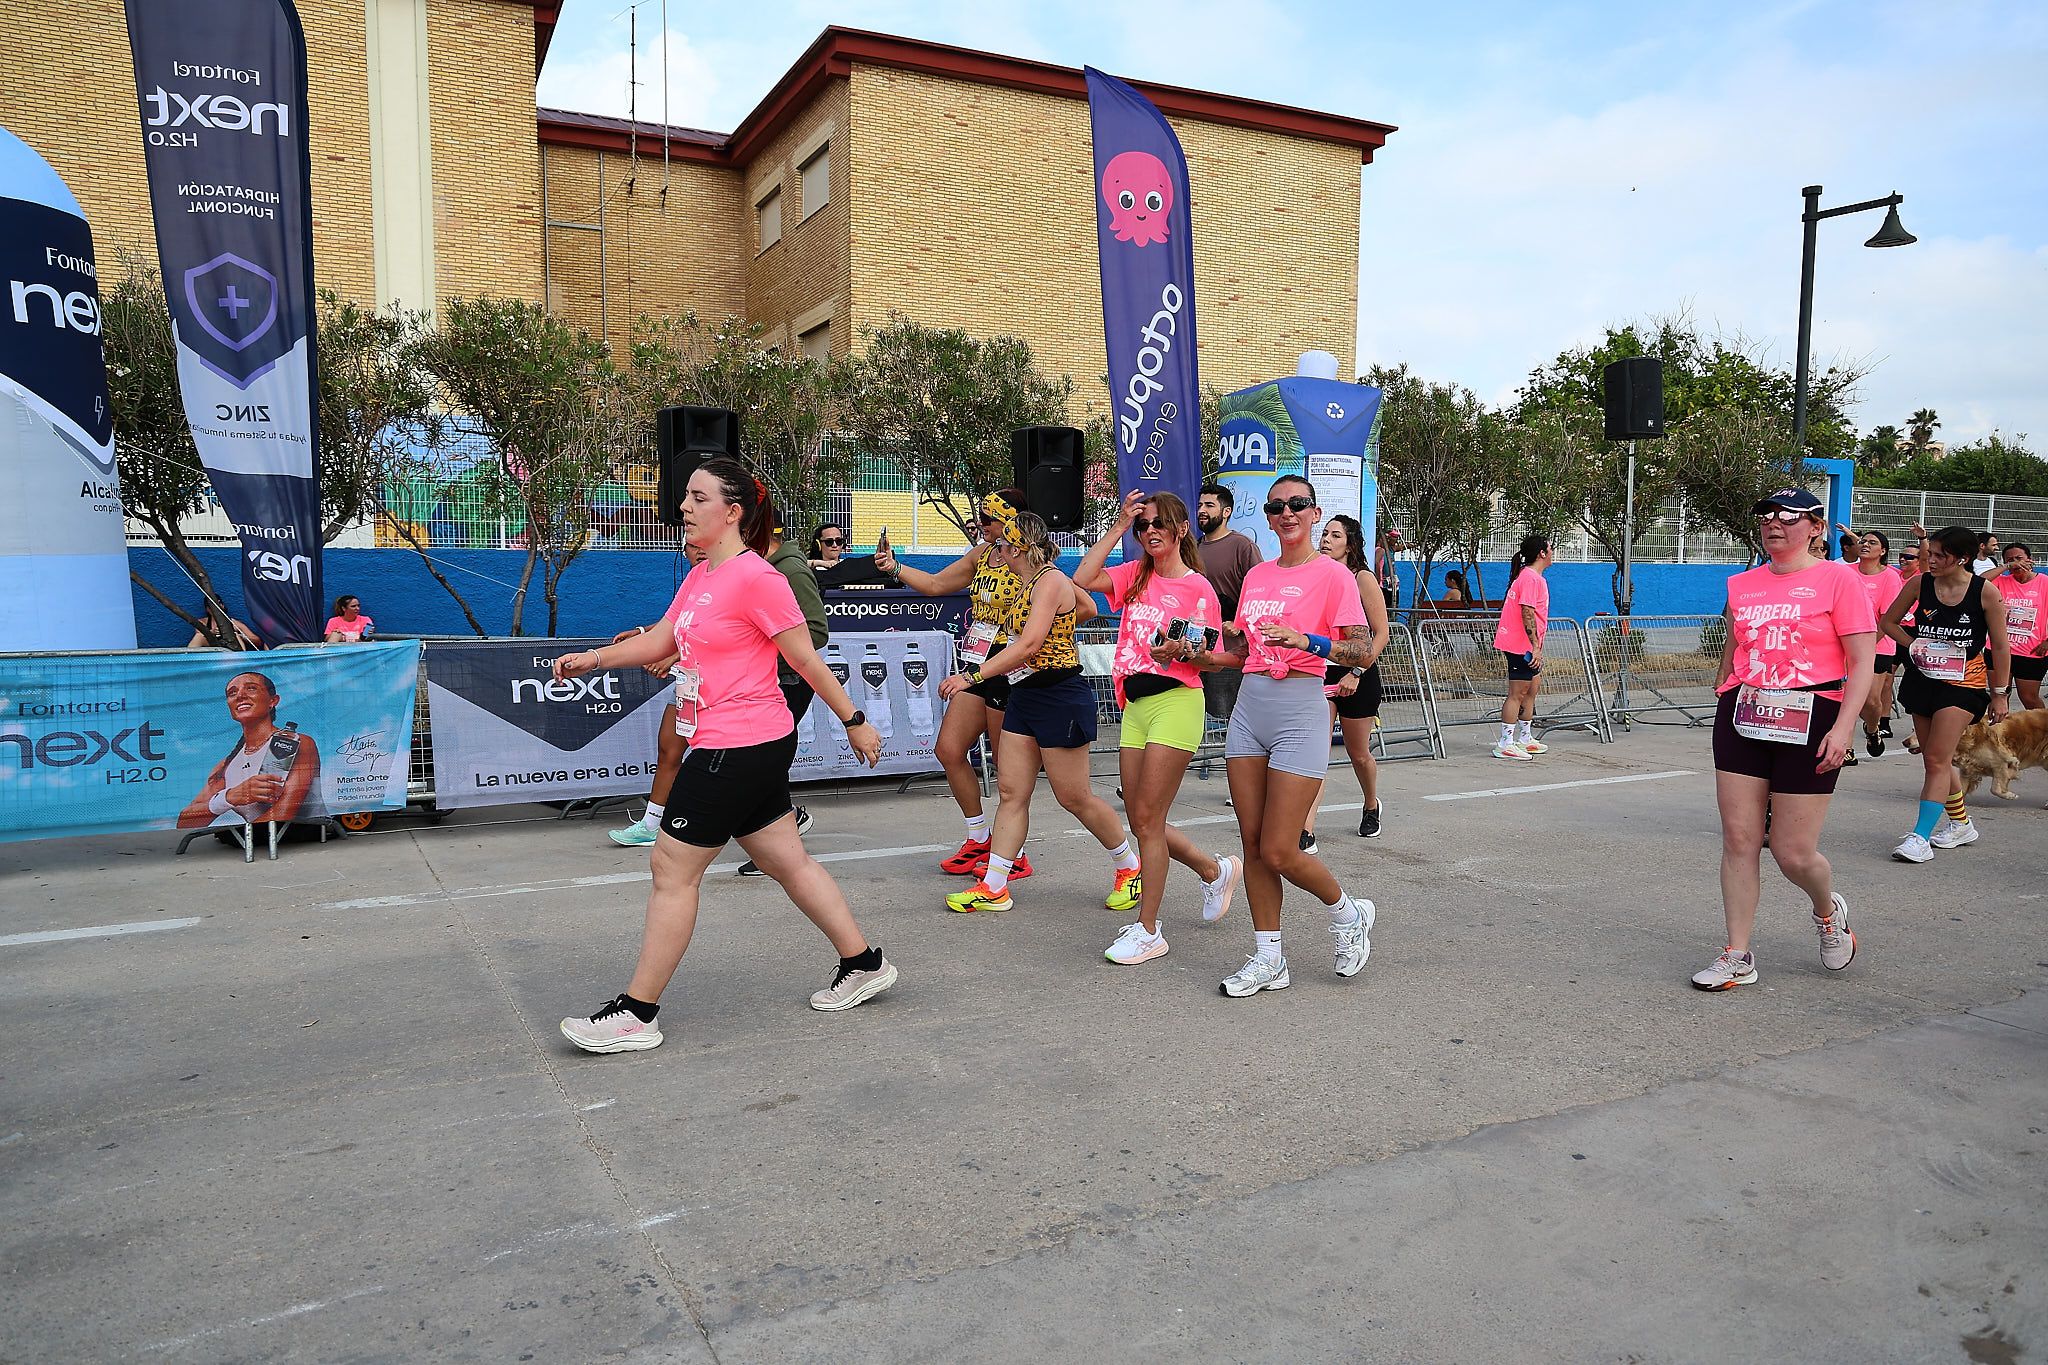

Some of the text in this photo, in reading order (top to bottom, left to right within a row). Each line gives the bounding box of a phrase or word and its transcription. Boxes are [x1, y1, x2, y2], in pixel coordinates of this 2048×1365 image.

[46, 246, 98, 280] Fontar
[823, 602, 944, 620] octopus energy
[1736, 604, 1801, 621] CARRERA
[1918, 624, 1973, 637] VALENCIA
[967, 636, 979, 646] 016
[1765, 625, 1789, 651] DE
[1926, 656, 1948, 664] 016
[865, 669, 883, 677] next
[907, 667, 924, 675] next
[511, 671, 621, 704] next
[18, 697, 126, 717] Fontarel
[585, 702, 622, 714] H2.0
[1756, 705, 1785, 718] 016
[0, 719, 166, 769] next
[274, 741, 294, 751] next
[792, 755, 824, 763] AGNESIO
[106, 766, 168, 785] H2.0
[337, 776, 365, 784] Marta
[475, 773, 500, 788] La
[504, 768, 569, 785] nueva
[573, 764, 610, 780] era
[614, 763, 640, 777] de
[365, 784, 385, 793] joven
[359, 792, 386, 800] mundia
